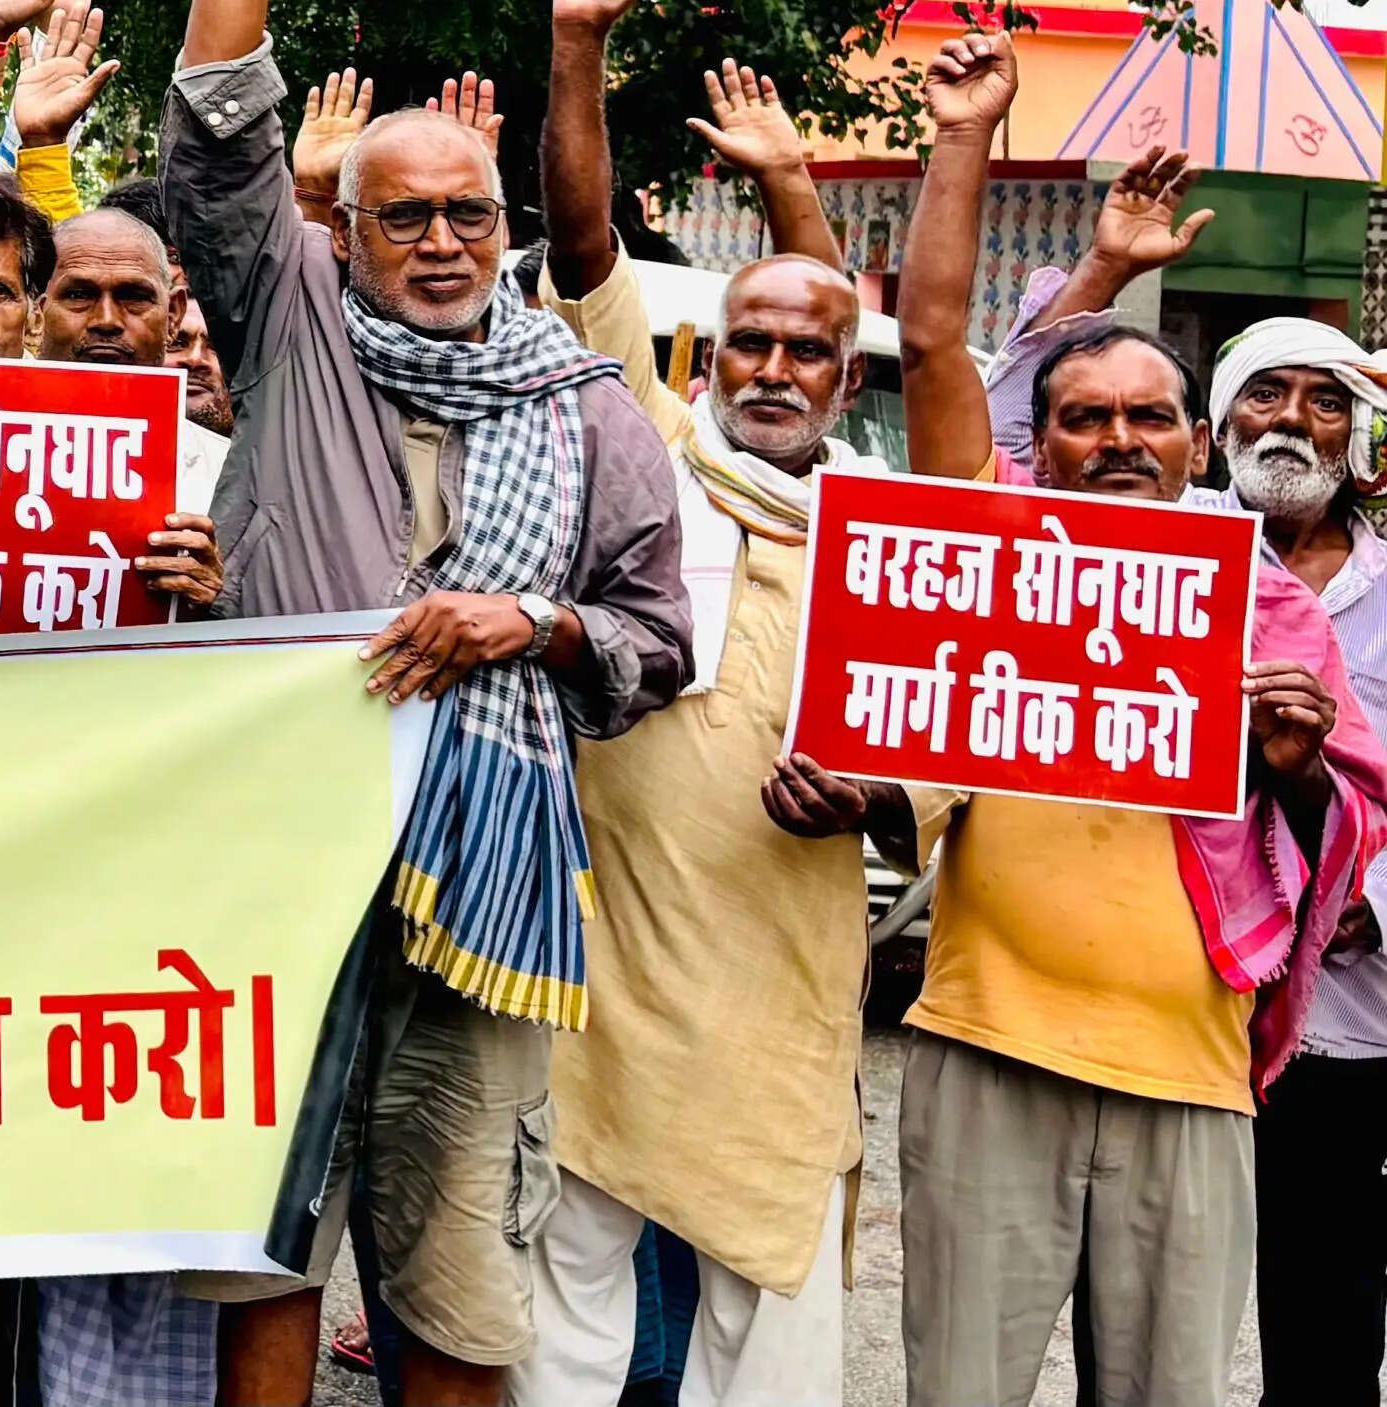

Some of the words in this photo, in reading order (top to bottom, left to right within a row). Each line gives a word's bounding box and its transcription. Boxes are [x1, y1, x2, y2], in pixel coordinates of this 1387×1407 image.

[22, 531, 131, 632] करो
[845, 520, 1002, 617] बरहज
[1012, 515, 1220, 666] सोनूघाट
[844, 641, 958, 753] मार्ग
[969, 650, 1079, 764] ठीक
[1093, 667, 1199, 779] करो
